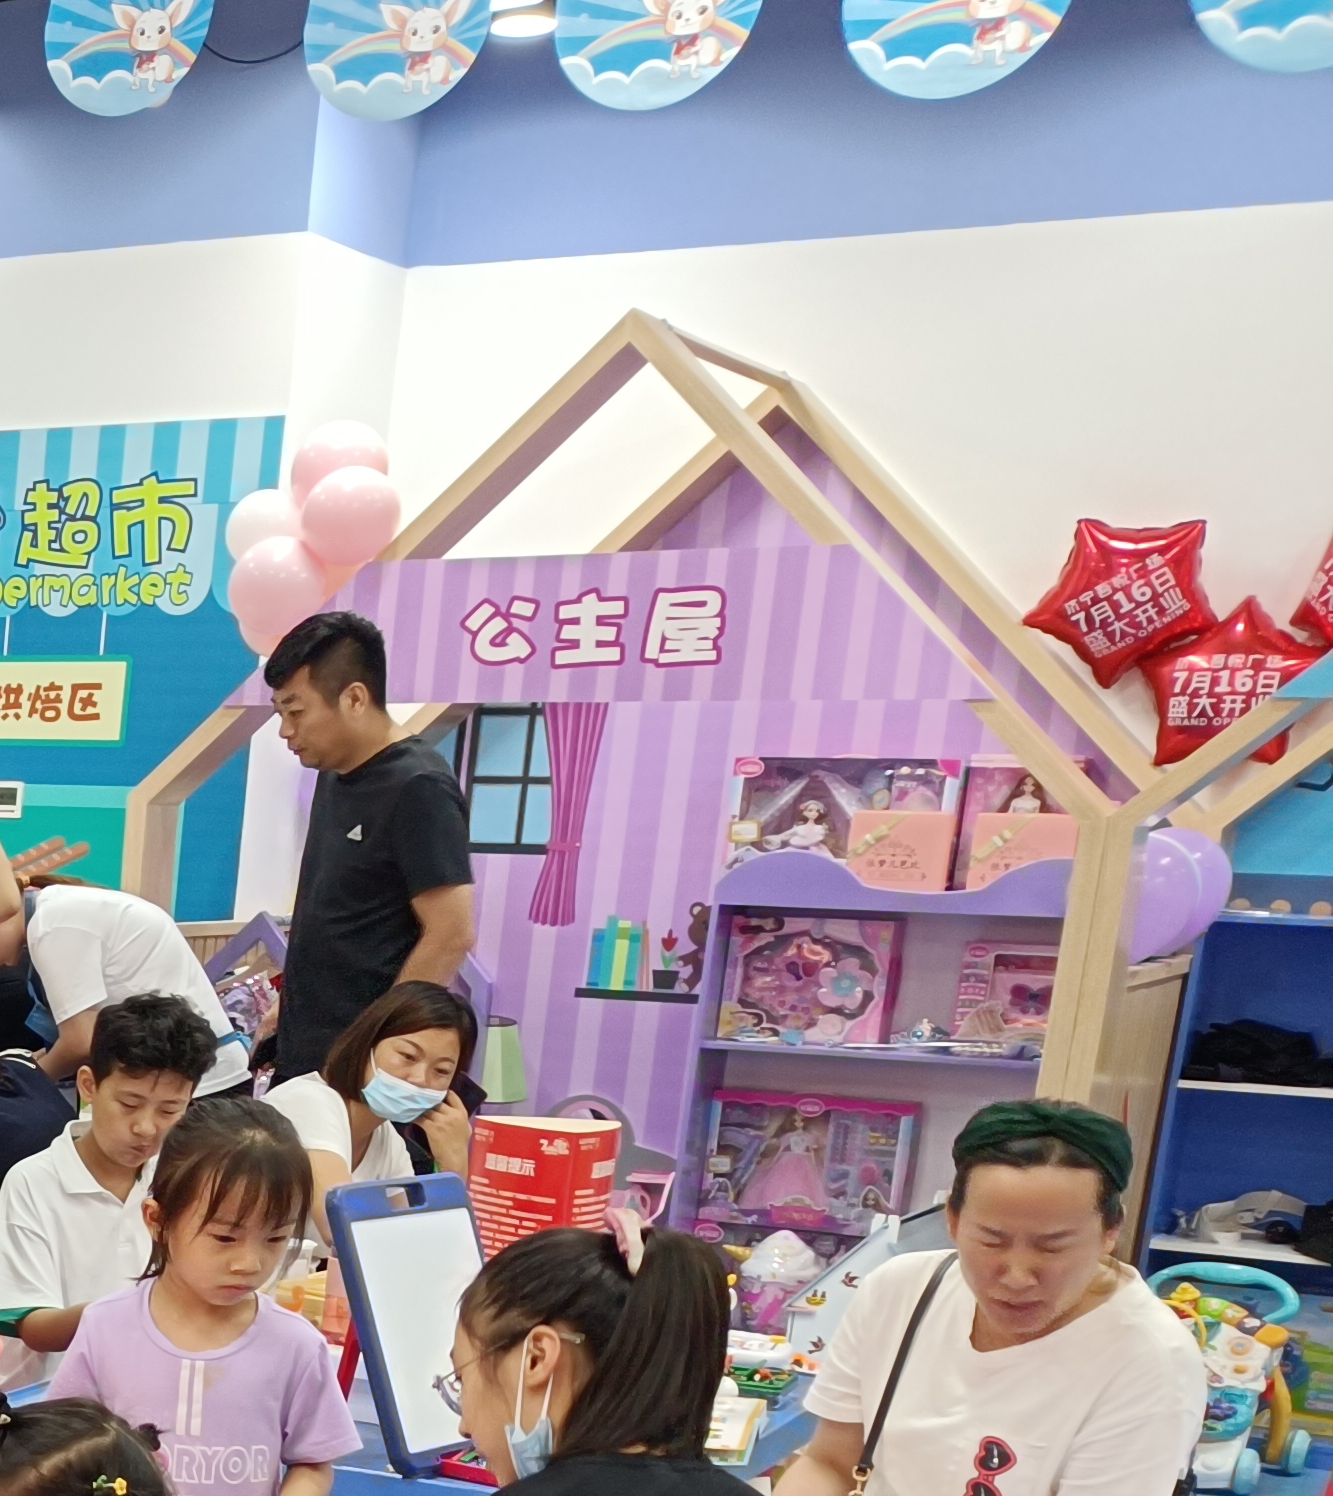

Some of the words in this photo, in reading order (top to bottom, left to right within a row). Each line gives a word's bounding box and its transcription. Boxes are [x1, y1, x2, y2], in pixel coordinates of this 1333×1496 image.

[15, 472, 198, 569] 超市
[460, 585, 726, 669] 公主屋
[1070, 566, 1176, 633] 7月16日
[1173, 671, 1282, 693] 7月16日
